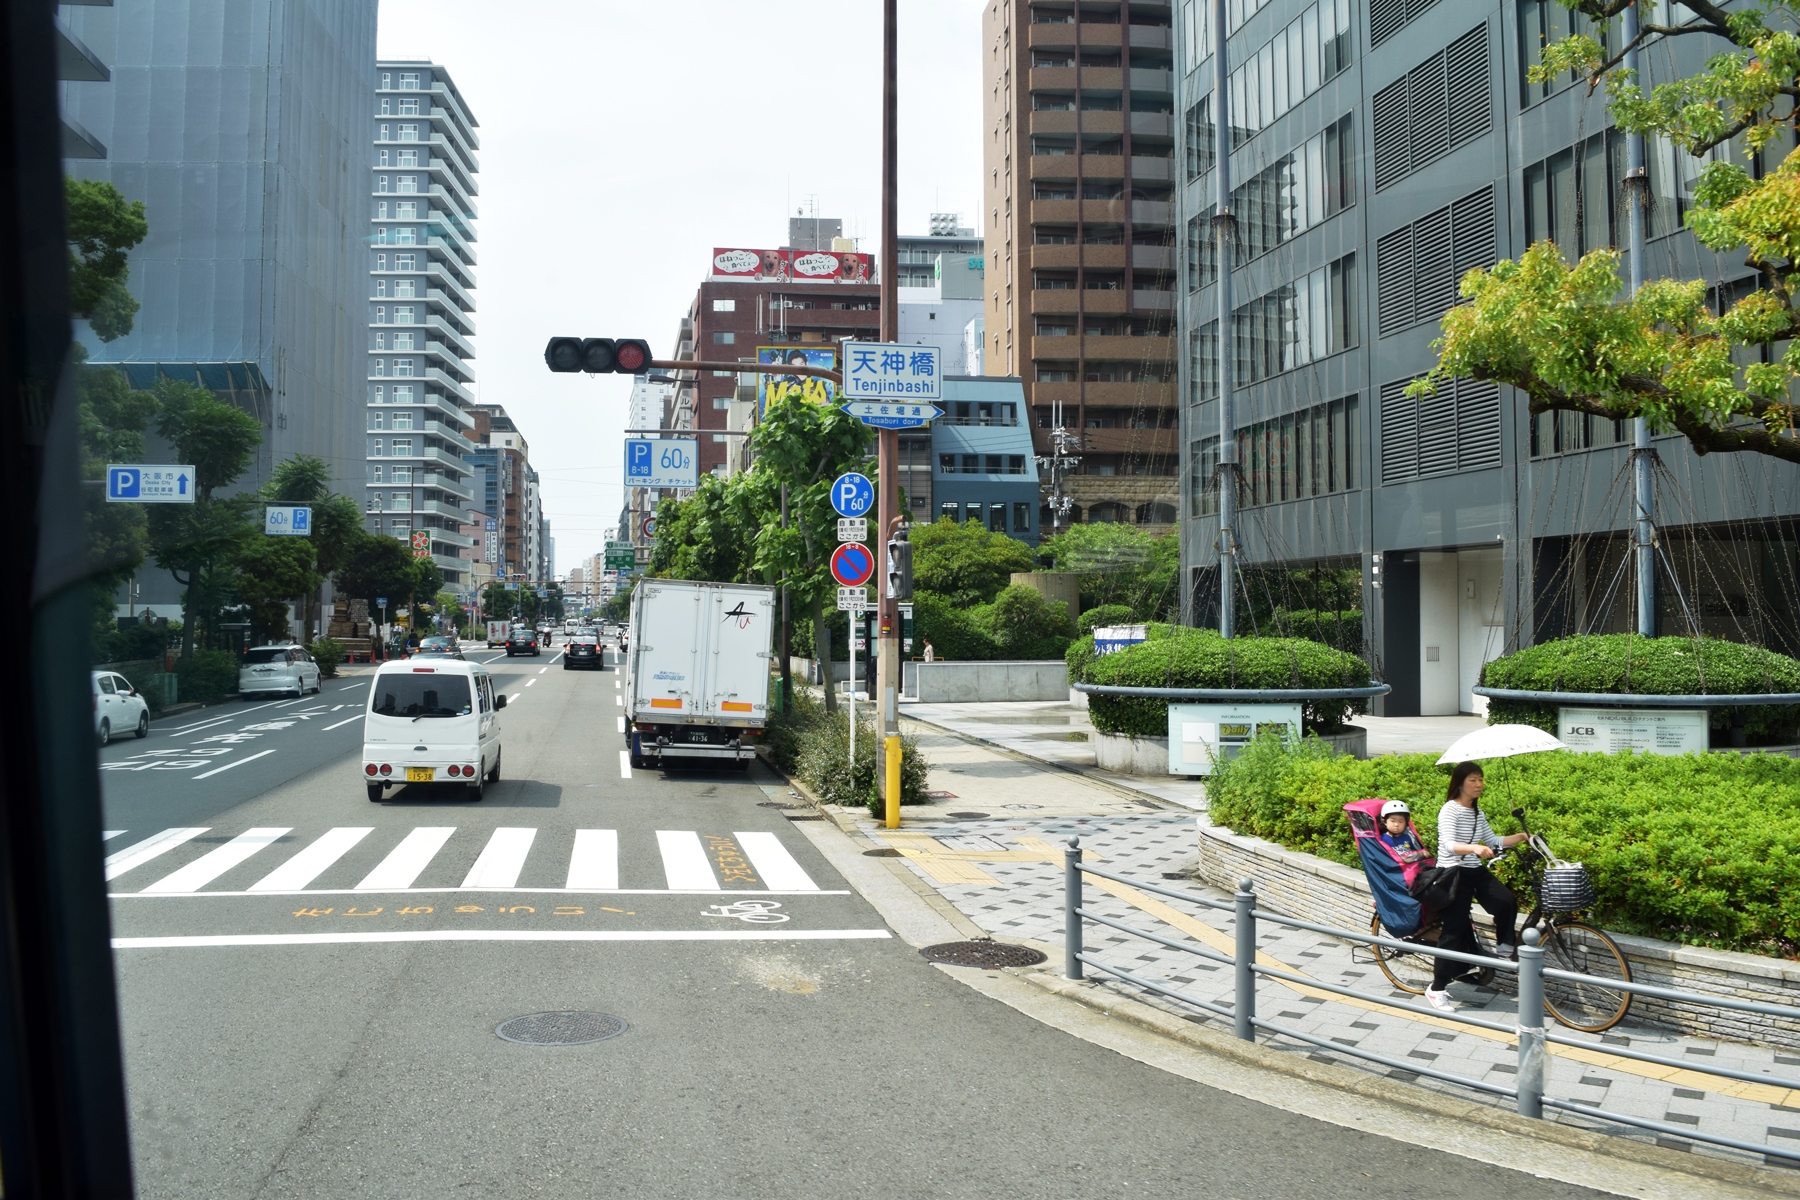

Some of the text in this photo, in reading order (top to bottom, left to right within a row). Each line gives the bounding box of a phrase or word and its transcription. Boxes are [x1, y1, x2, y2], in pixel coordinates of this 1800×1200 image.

[852, 350, 934, 377] 天神橋
[852, 377, 934, 394] Tenjinbashi
[864, 405, 921, 416] 土佐堀通
[868, 416, 917, 425] Tosabori dori
[635, 444, 648, 464] P
[660, 447, 690, 469] 60分
[631, 465, 649, 474] 8-18
[142, 472, 174, 480] 大阪市
[844, 476, 860, 484] 8-18
[117, 471, 134, 495] P
[841, 483, 857, 510] P
[296, 510, 305, 522] P
[1221, 724, 1249, 736] Daily
[1567, 727, 1595, 735] JCB
